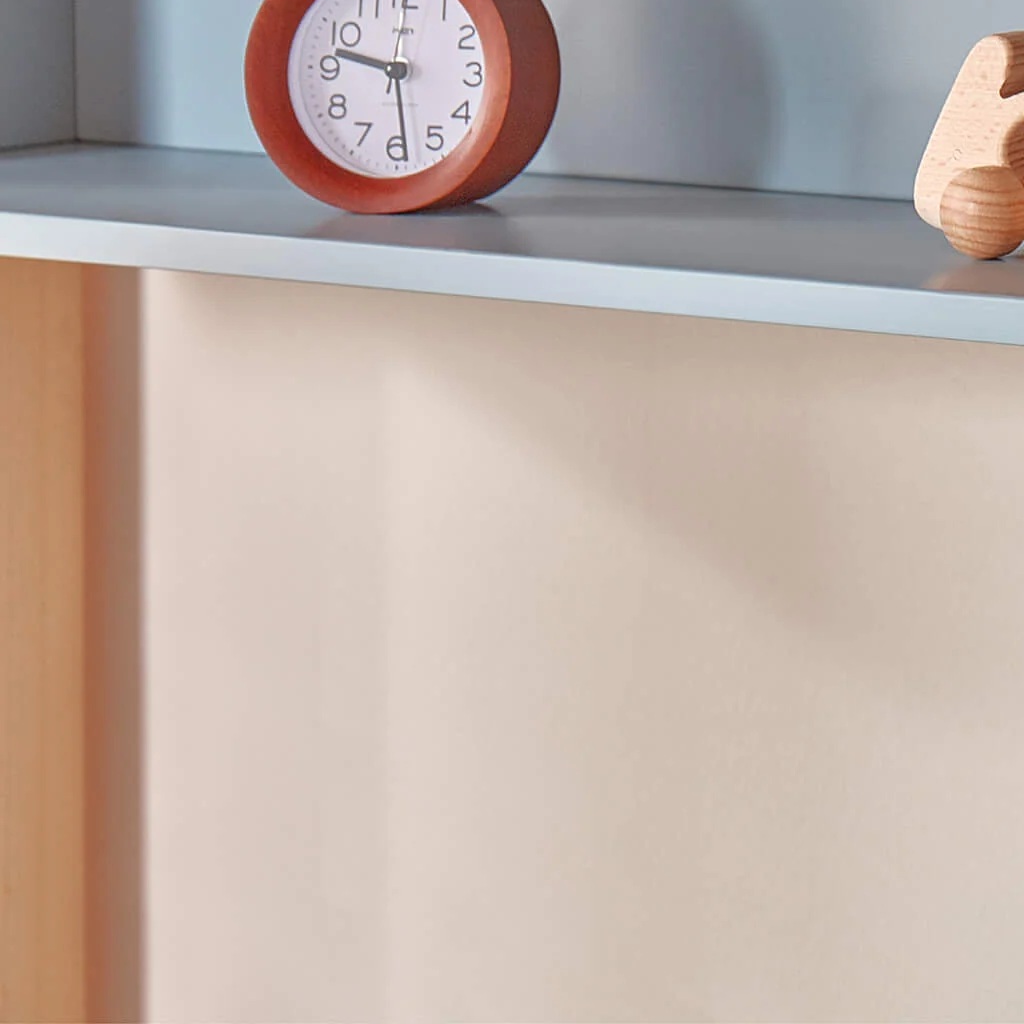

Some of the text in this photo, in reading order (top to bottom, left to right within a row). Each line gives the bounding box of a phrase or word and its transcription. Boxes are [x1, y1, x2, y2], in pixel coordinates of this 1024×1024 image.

[331, 21, 362, 47] 10
[458, 25, 476, 50] 2
[320, 55, 340, 81] 9
[463, 62, 483, 87] 3
[328, 93, 347, 120] 8
[451, 100, 472, 125] 4
[354, 122, 373, 147] 7
[425, 125, 444, 151] 5
[386, 135, 407, 161] 6
